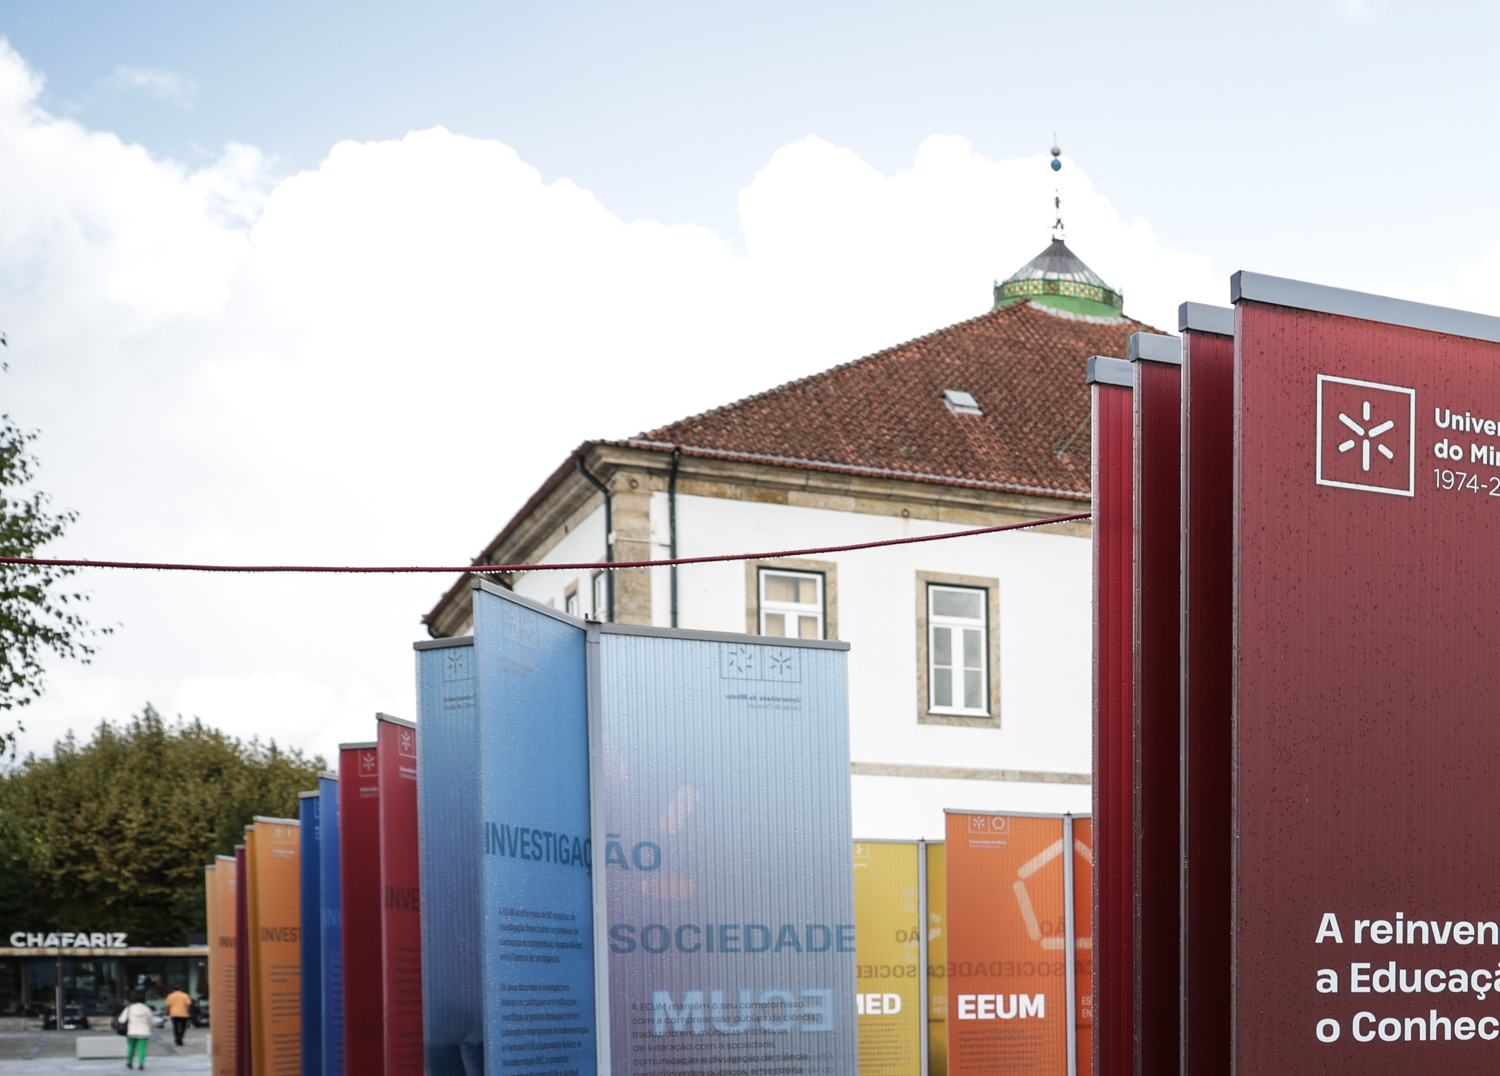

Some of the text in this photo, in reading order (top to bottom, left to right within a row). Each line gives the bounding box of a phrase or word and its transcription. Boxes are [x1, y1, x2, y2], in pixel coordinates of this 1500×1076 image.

[1434, 438, 1464, 461] do
[10, 932, 128, 948] CHAFARIZ
[609, 923, 856, 954] SOCIEDADE
[1315, 912, 1343, 944] A
[1316, 968, 1339, 993] a
[958, 994, 1045, 1019] EEUM
[1316, 1018, 1341, 1044] o
